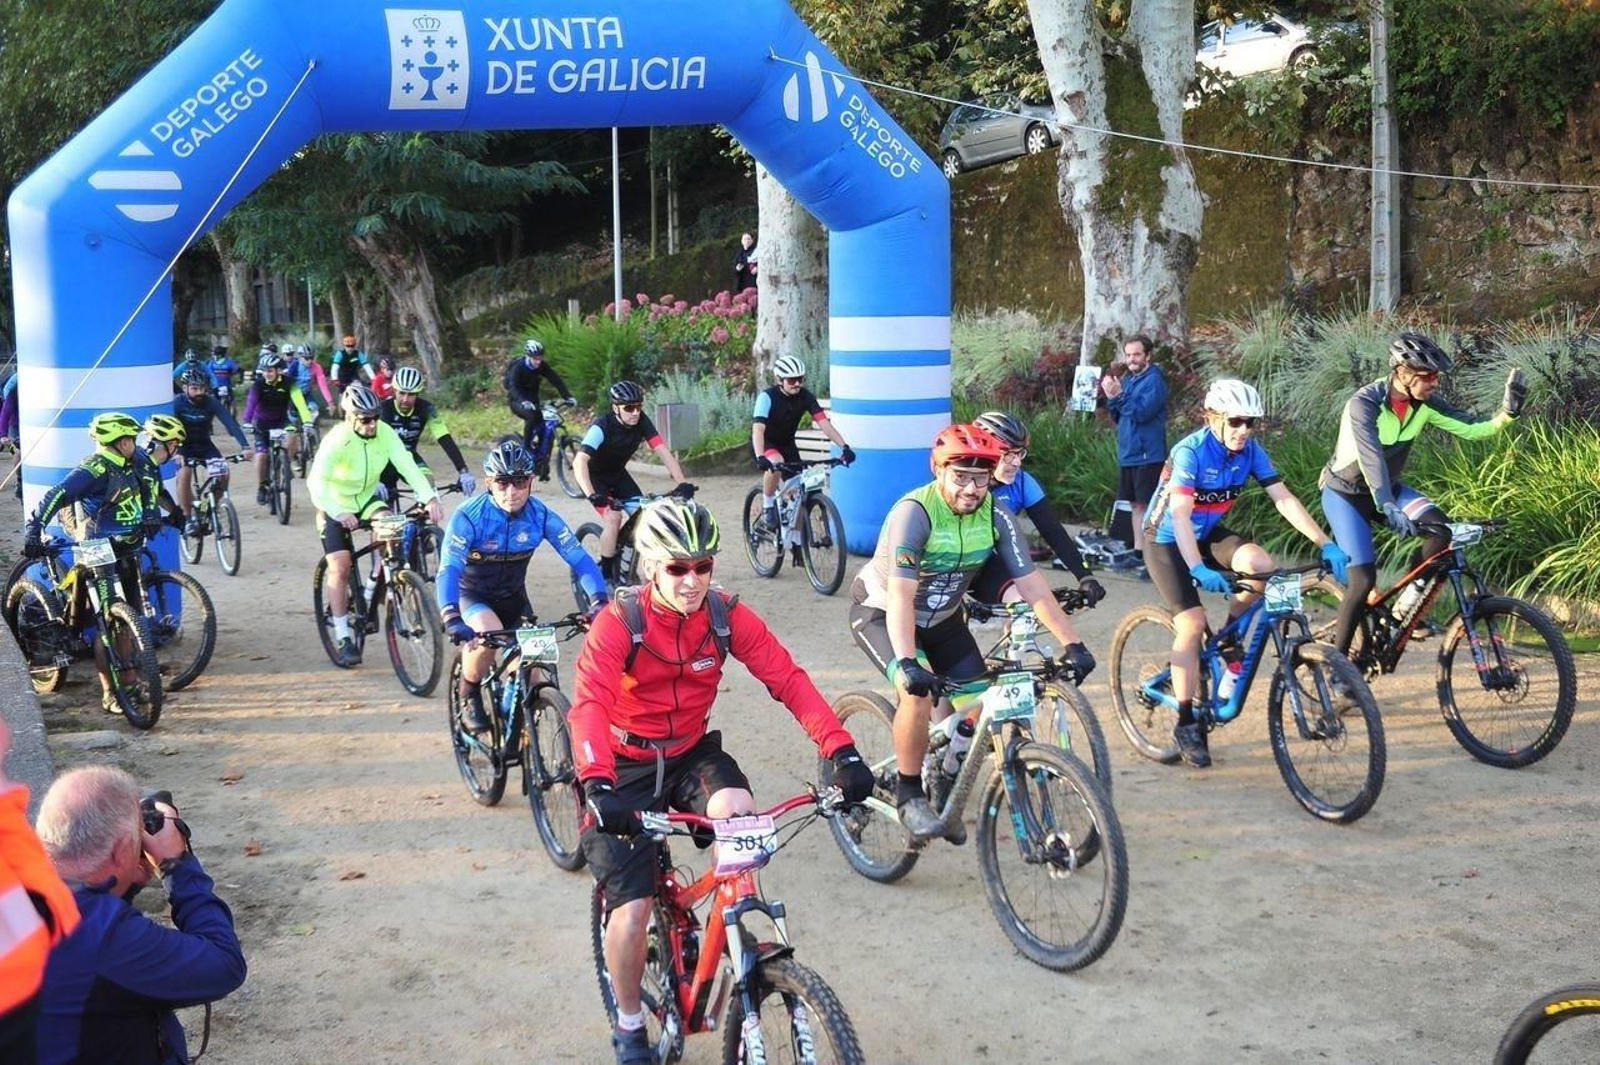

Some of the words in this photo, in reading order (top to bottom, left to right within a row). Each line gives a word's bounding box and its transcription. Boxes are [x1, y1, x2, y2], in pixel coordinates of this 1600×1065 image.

[483, 16, 624, 50] XUNTA
[486, 60, 537, 94] DE
[548, 56, 706, 93] GALICIA
[150, 48, 262, 142] DEPORTE
[172, 77, 268, 158] GALEGO
[849, 94, 922, 173] DEPORTE
[840, 111, 905, 178] GALEGO
[532, 639, 547, 649] 20
[1004, 686, 1021, 699] 49
[733, 834, 764, 852] 301
